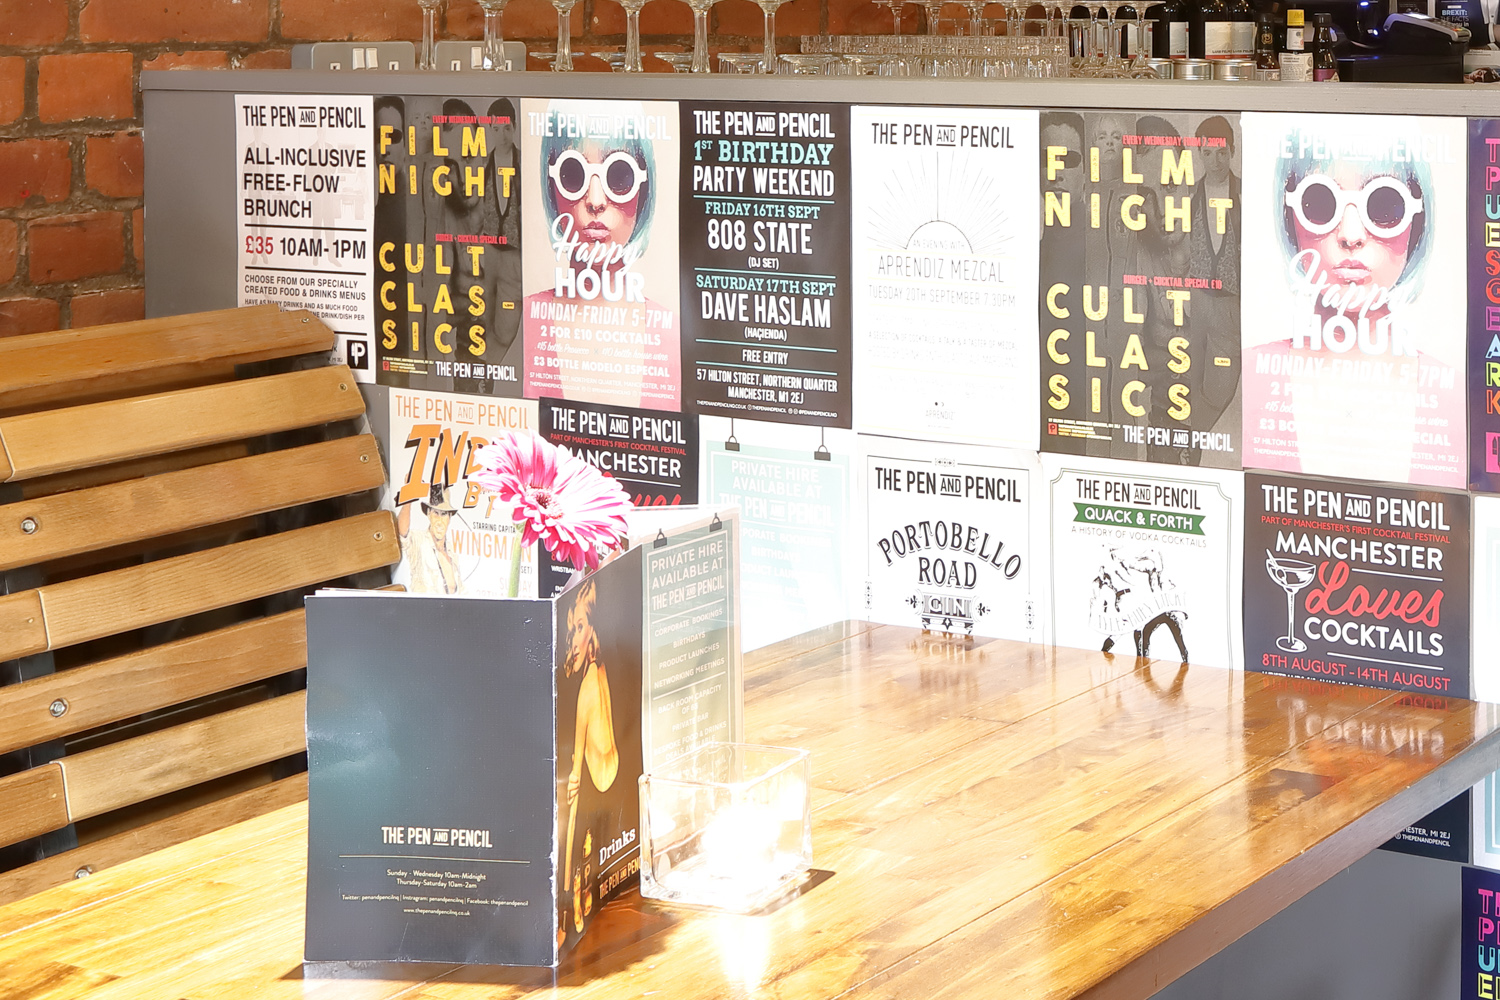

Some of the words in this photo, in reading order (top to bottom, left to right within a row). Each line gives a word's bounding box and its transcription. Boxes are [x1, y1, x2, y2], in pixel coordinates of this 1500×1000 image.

[243, 105, 267, 127] THE
[271, 106, 296, 127] PEN
[300, 110, 315, 124] AND
[320, 107, 366, 128] PENCIL
[244, 147, 366, 167] ALL-INCLUSIVE
[380, 125, 487, 157] FILM
[244, 173, 339, 193] FREE-FLOW
[379, 164, 515, 198] NIGHT
[245, 199, 312, 218] BRUNCH
[379, 241, 484, 276] CULT
[551, 212, 644, 273] Happy
[245, 274, 275, 284] CHOOSE
[277, 276, 297, 285] FROM
[300, 277, 316, 286] OUR
[318, 278, 358, 289] SPECIALLY
[245, 285, 276, 295] CREATED
[278, 287, 300, 296] FOOD
[302, 288, 307, 297] &
[309, 289, 337, 299] DRINKS
[339, 290, 366, 300] MENUS
[555, 267, 646, 303] HOUR
[1084, 508, 1133, 524] QUACK
[1136, 512, 1146, 526] &
[1150, 513, 1193, 530] FORTH
[651, 549, 695, 572] PRIVATE
[698, 540, 723, 558] HIRE
[878, 521, 1022, 579] PORTOBELLO
[1276, 530, 1443, 571] MANCHESTER
[652, 562, 709, 589] AVAILABLE
[711, 558, 724, 572] AT
[918, 556, 977, 588] ROAD
[1305, 560, 1444, 628] Loves
[1304, 616, 1443, 657] COCKTAILS
[381, 827, 404, 844] THE
[408, 828, 430, 845] PEN
[434, 832, 448, 842] AND
[451, 829, 492, 848] PENCIL
